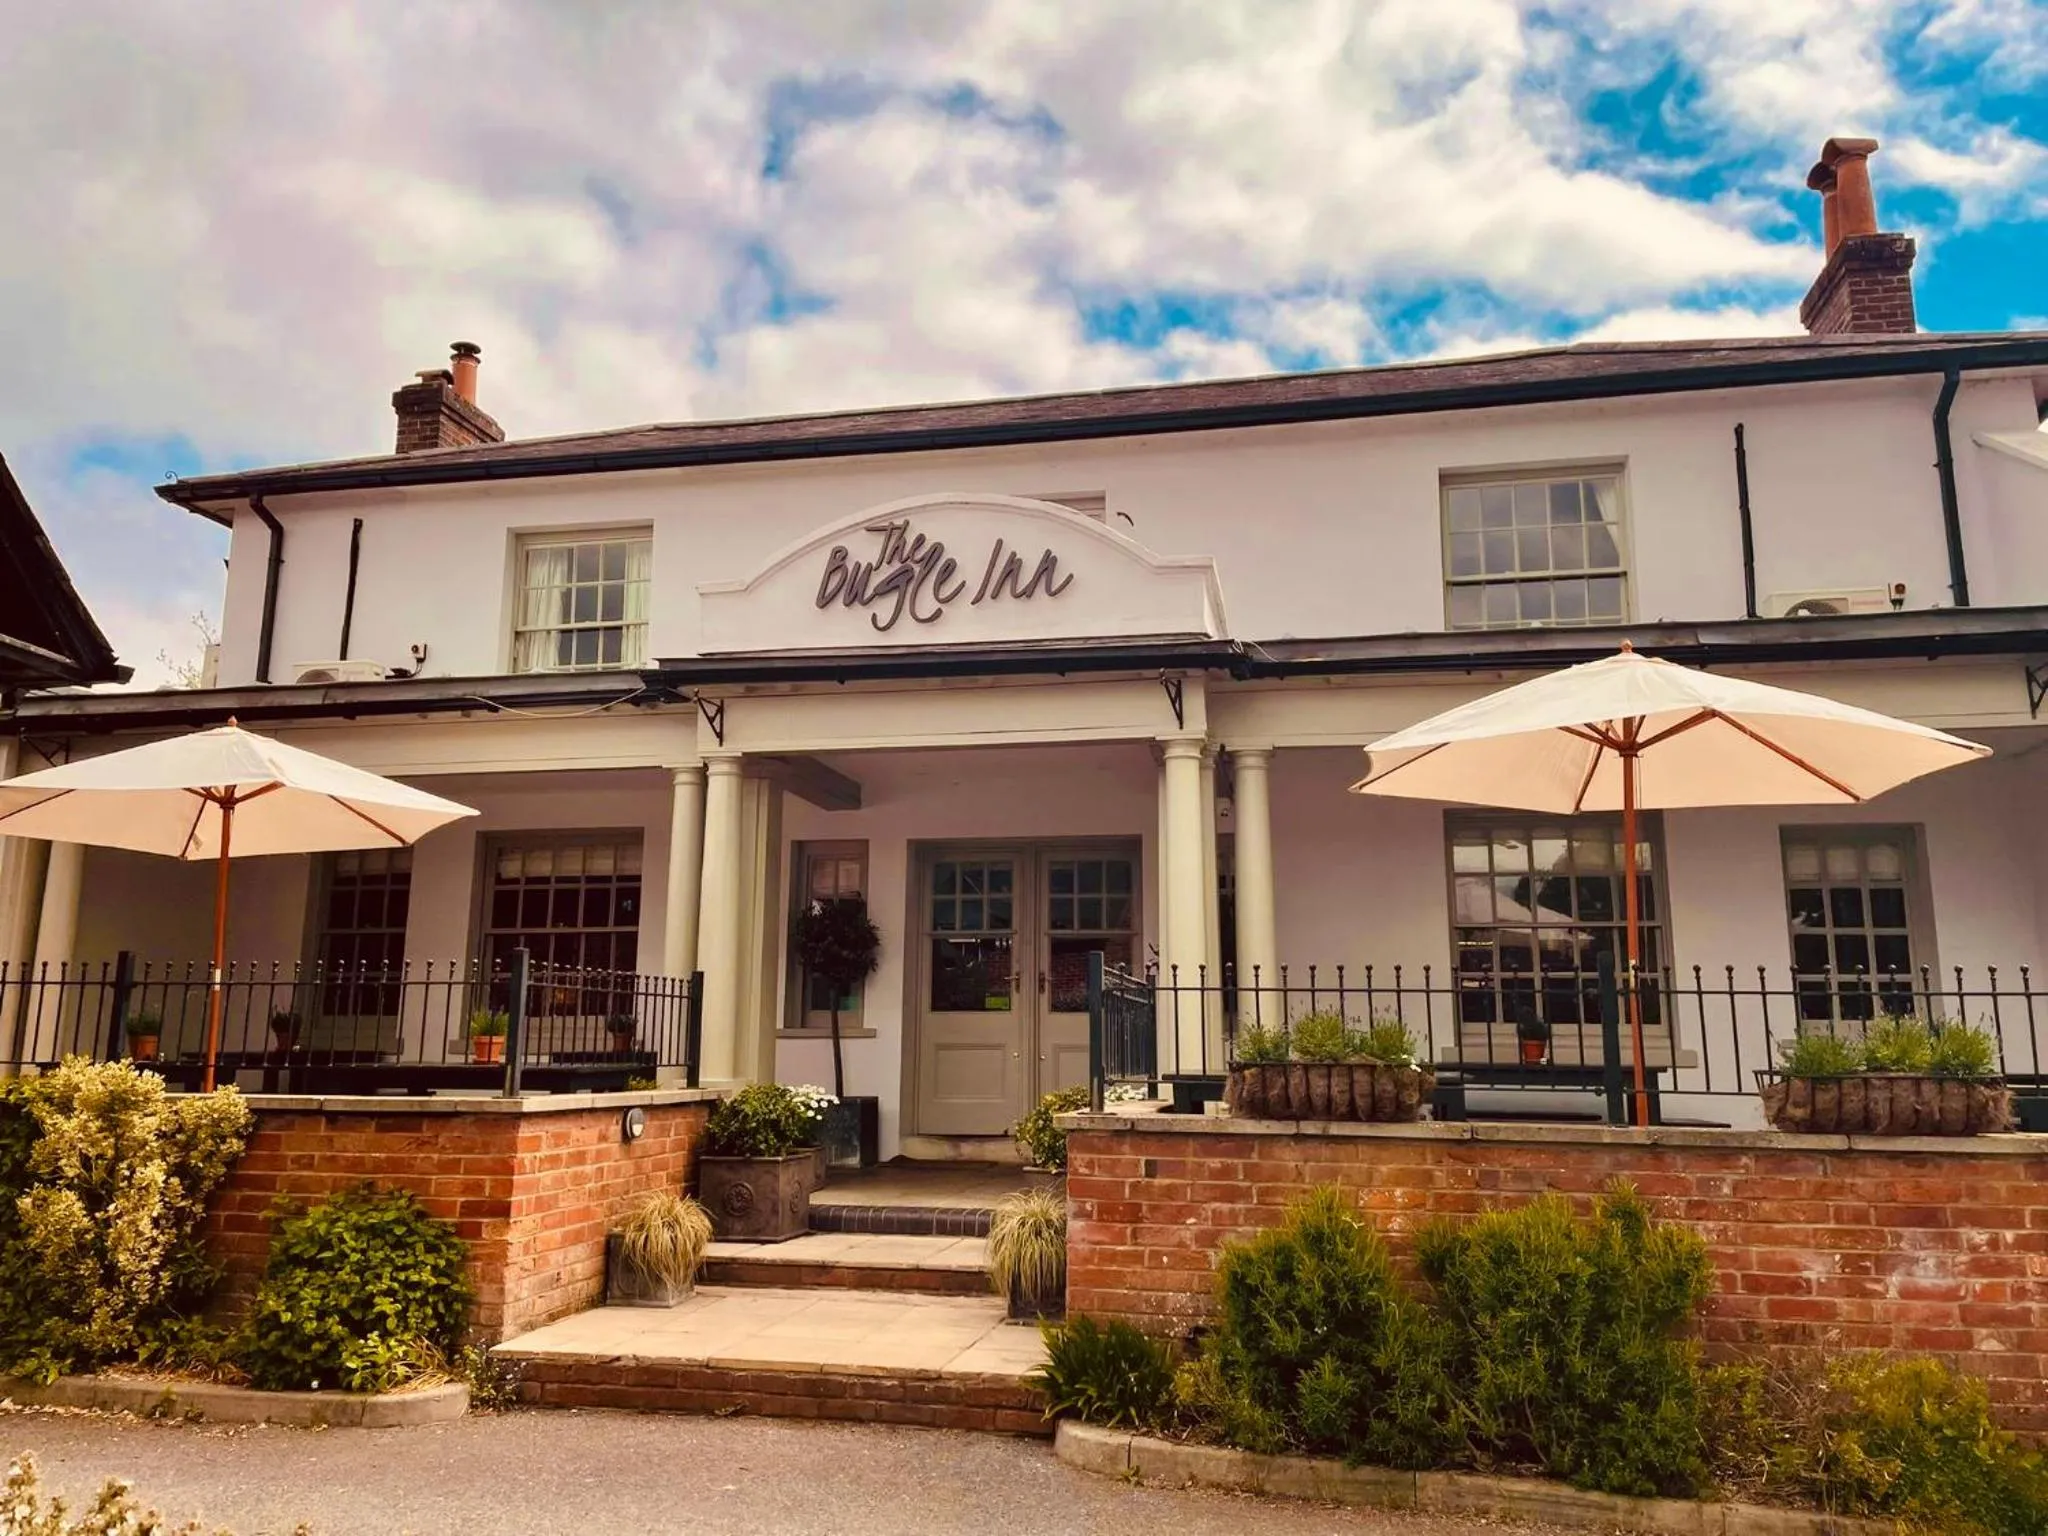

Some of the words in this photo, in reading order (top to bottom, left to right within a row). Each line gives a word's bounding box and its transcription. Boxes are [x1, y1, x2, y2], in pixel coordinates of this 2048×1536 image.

[864, 519, 928, 572] The
[815, 543, 966, 632] Bugle
[971, 538, 1074, 606] Inn
